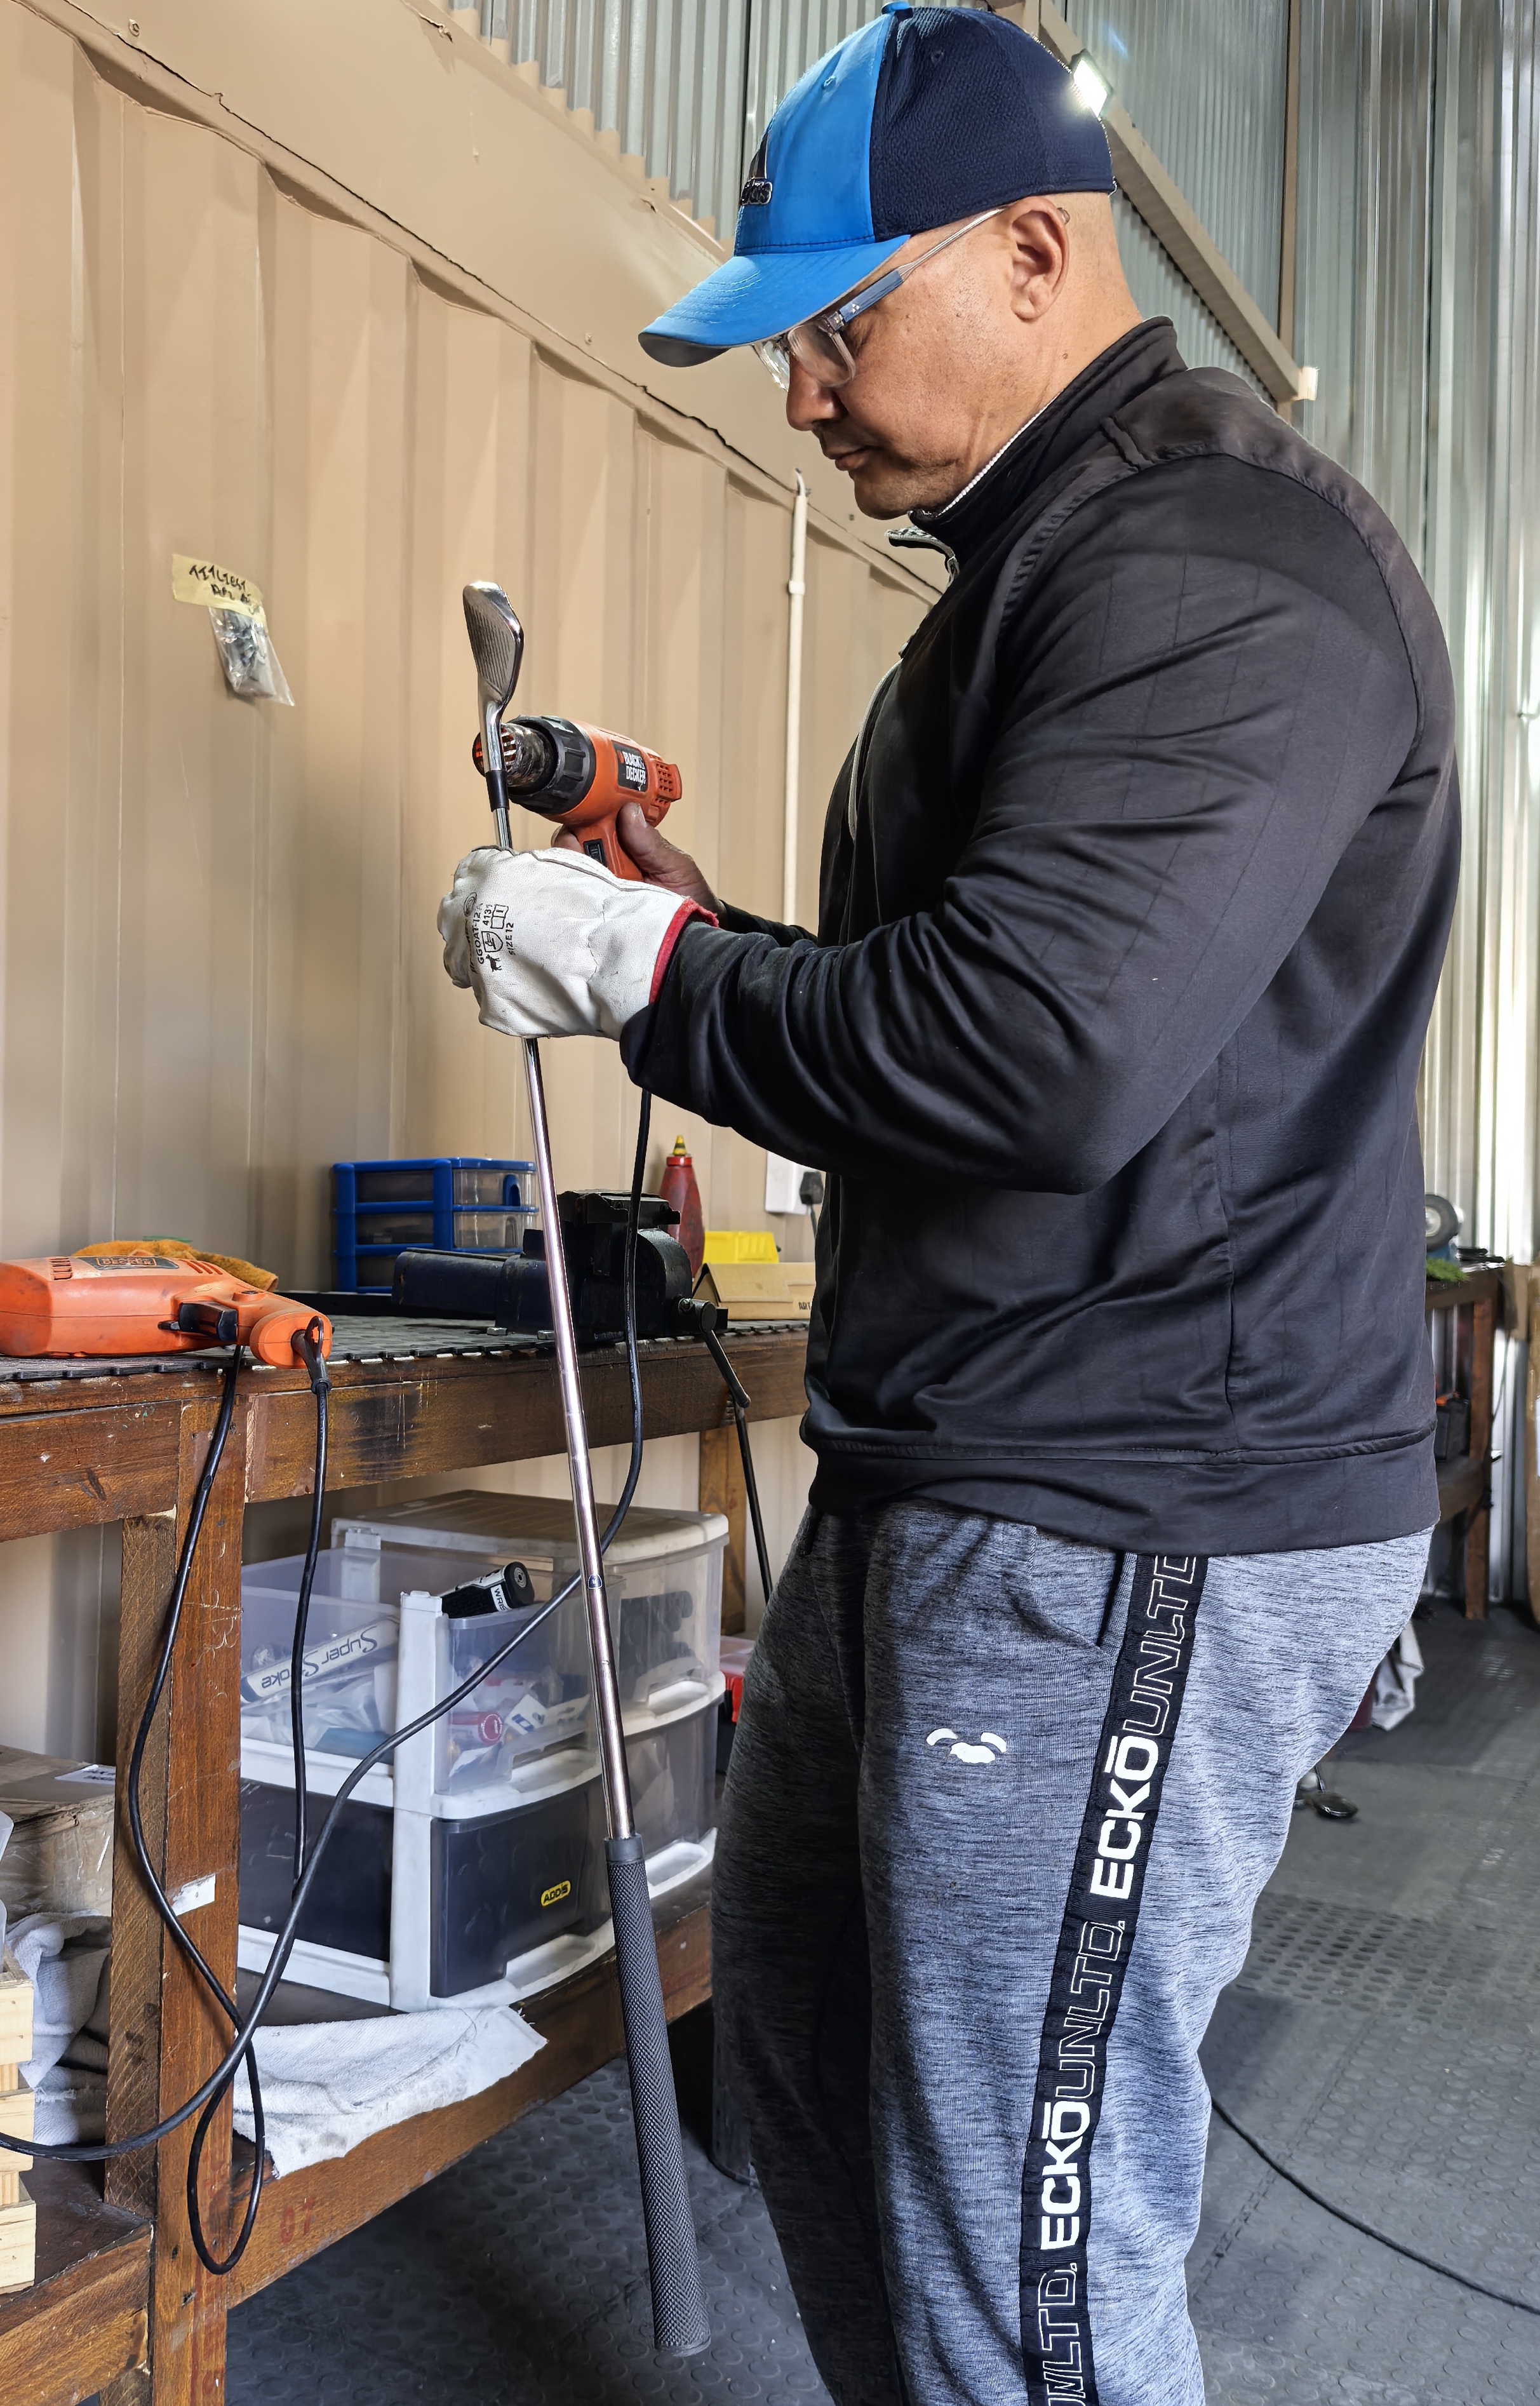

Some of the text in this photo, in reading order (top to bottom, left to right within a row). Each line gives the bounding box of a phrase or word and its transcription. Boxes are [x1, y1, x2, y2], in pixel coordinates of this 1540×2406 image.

[626, 765, 646, 784] DECKER
[505, 922, 516, 955] SIZE 12
